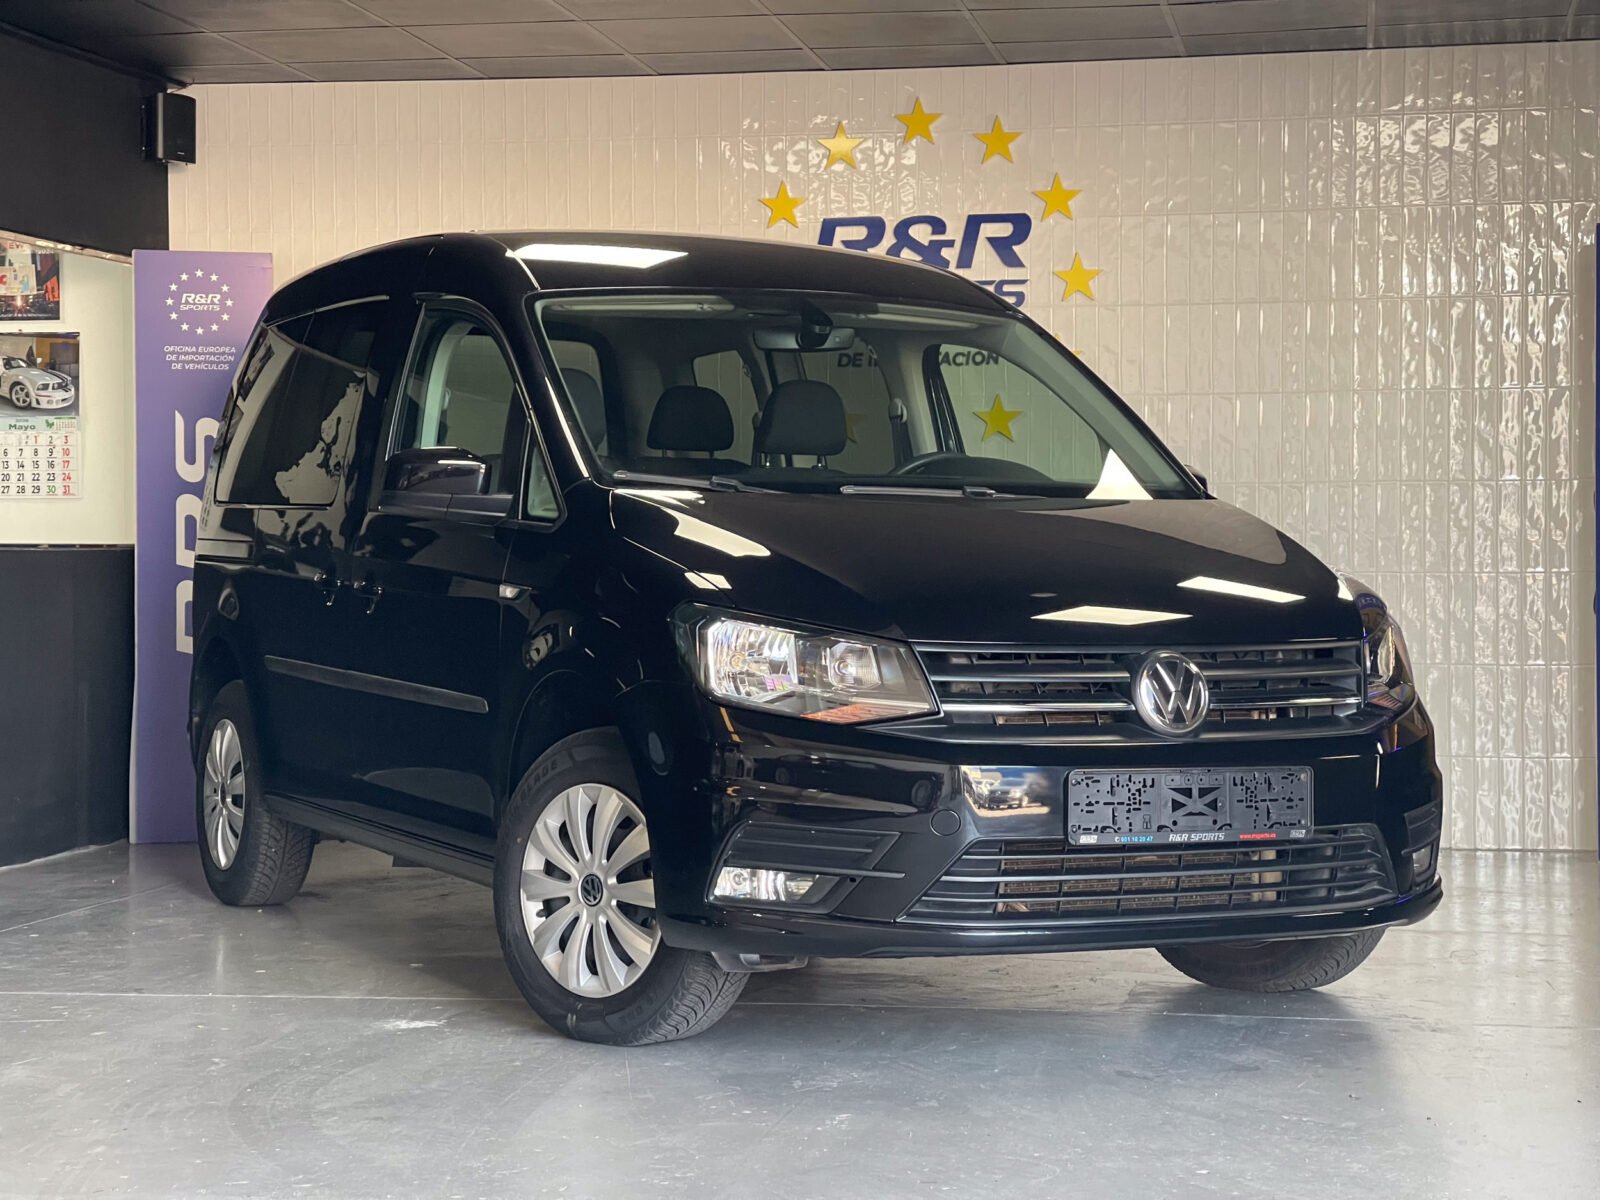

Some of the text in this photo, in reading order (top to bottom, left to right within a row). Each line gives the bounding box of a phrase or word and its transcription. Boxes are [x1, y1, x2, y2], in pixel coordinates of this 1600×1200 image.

[817, 213, 1032, 268] R&R
[181, 293, 221, 304] R&R
[163, 345, 197, 353] OFICINA
[179, 353, 235, 362] IMPORTACIÓN
[837, 352, 864, 368] DE
[184, 362, 230, 370] VEHÍCULOS
[8, 423, 36, 431] Mayo
[34, 435, 69, 445] 1 2 3
[3, 448, 70, 457] 6 7 8 9 10
[2, 460, 71, 469] 13 14 15 16 17
[1, 473, 71, 482] 20 21 22 23 24
[1, 485, 71, 494] 27 28 29 30 31
[1169, 832, 1225, 842] R&R SPORTS
